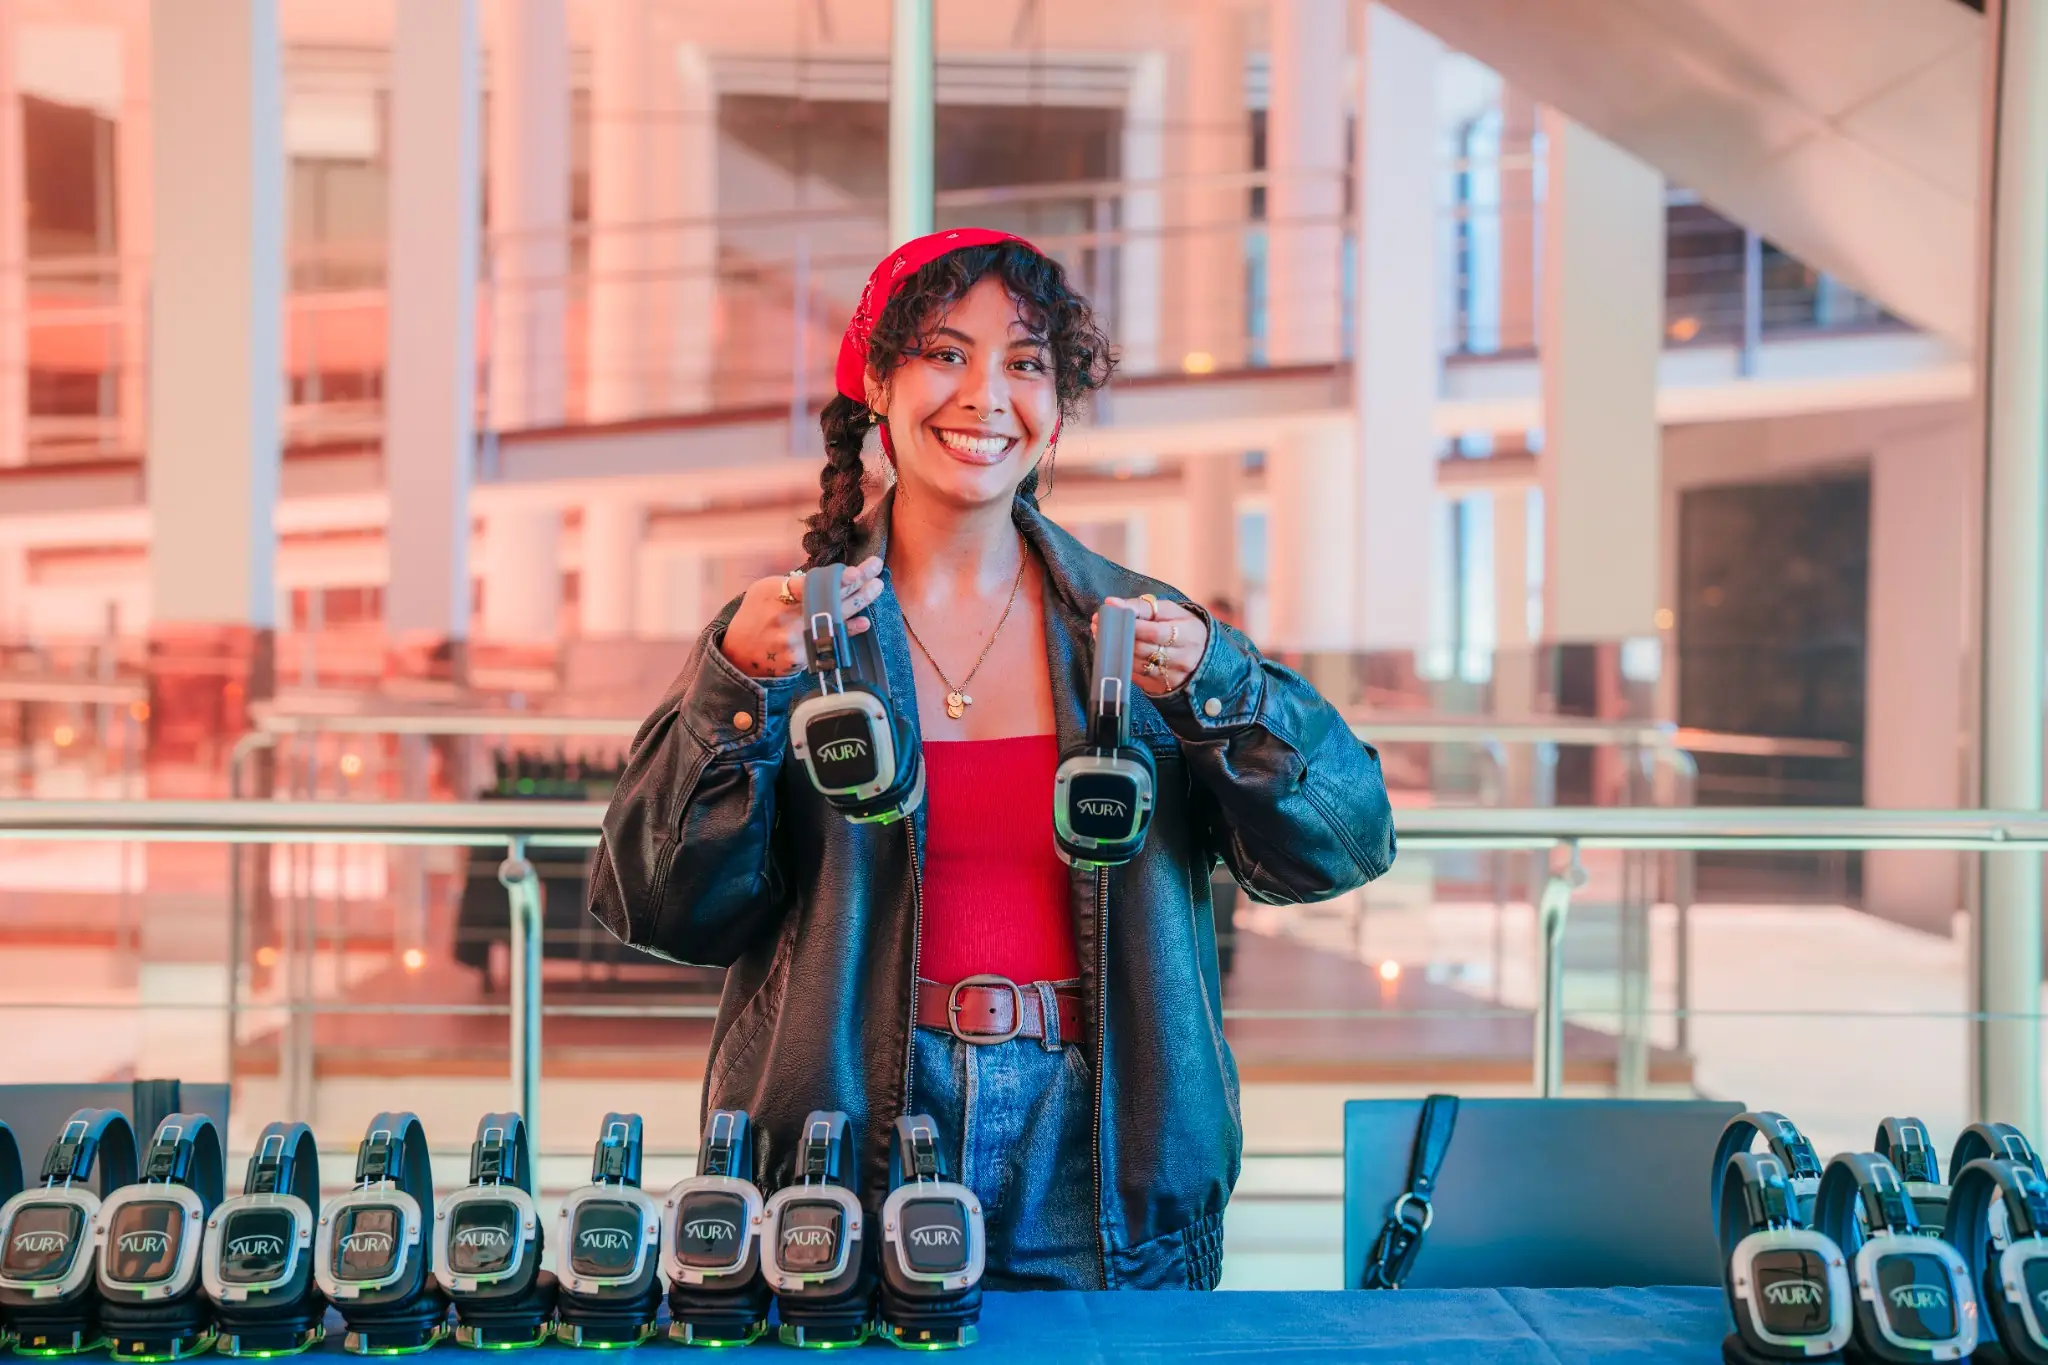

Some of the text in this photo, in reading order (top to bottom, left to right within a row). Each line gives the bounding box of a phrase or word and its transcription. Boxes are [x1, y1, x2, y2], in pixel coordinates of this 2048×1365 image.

[817, 738, 867, 763] AURA
[1076, 798, 1127, 817] AURA
[456, 1227, 509, 1246] AURA
[580, 1228, 632, 1250] AURA
[684, 1219, 736, 1240] AURA
[784, 1226, 836, 1246] AURA
[910, 1225, 962, 1246] AURA
[14, 1231, 69, 1251] AURA
[117, 1231, 172, 1252] AURA
[228, 1234, 284, 1256] AURA
[340, 1232, 393, 1252] AURA
[1764, 1280, 1823, 1304] AURA
[1890, 1284, 1948, 1308] AURA
